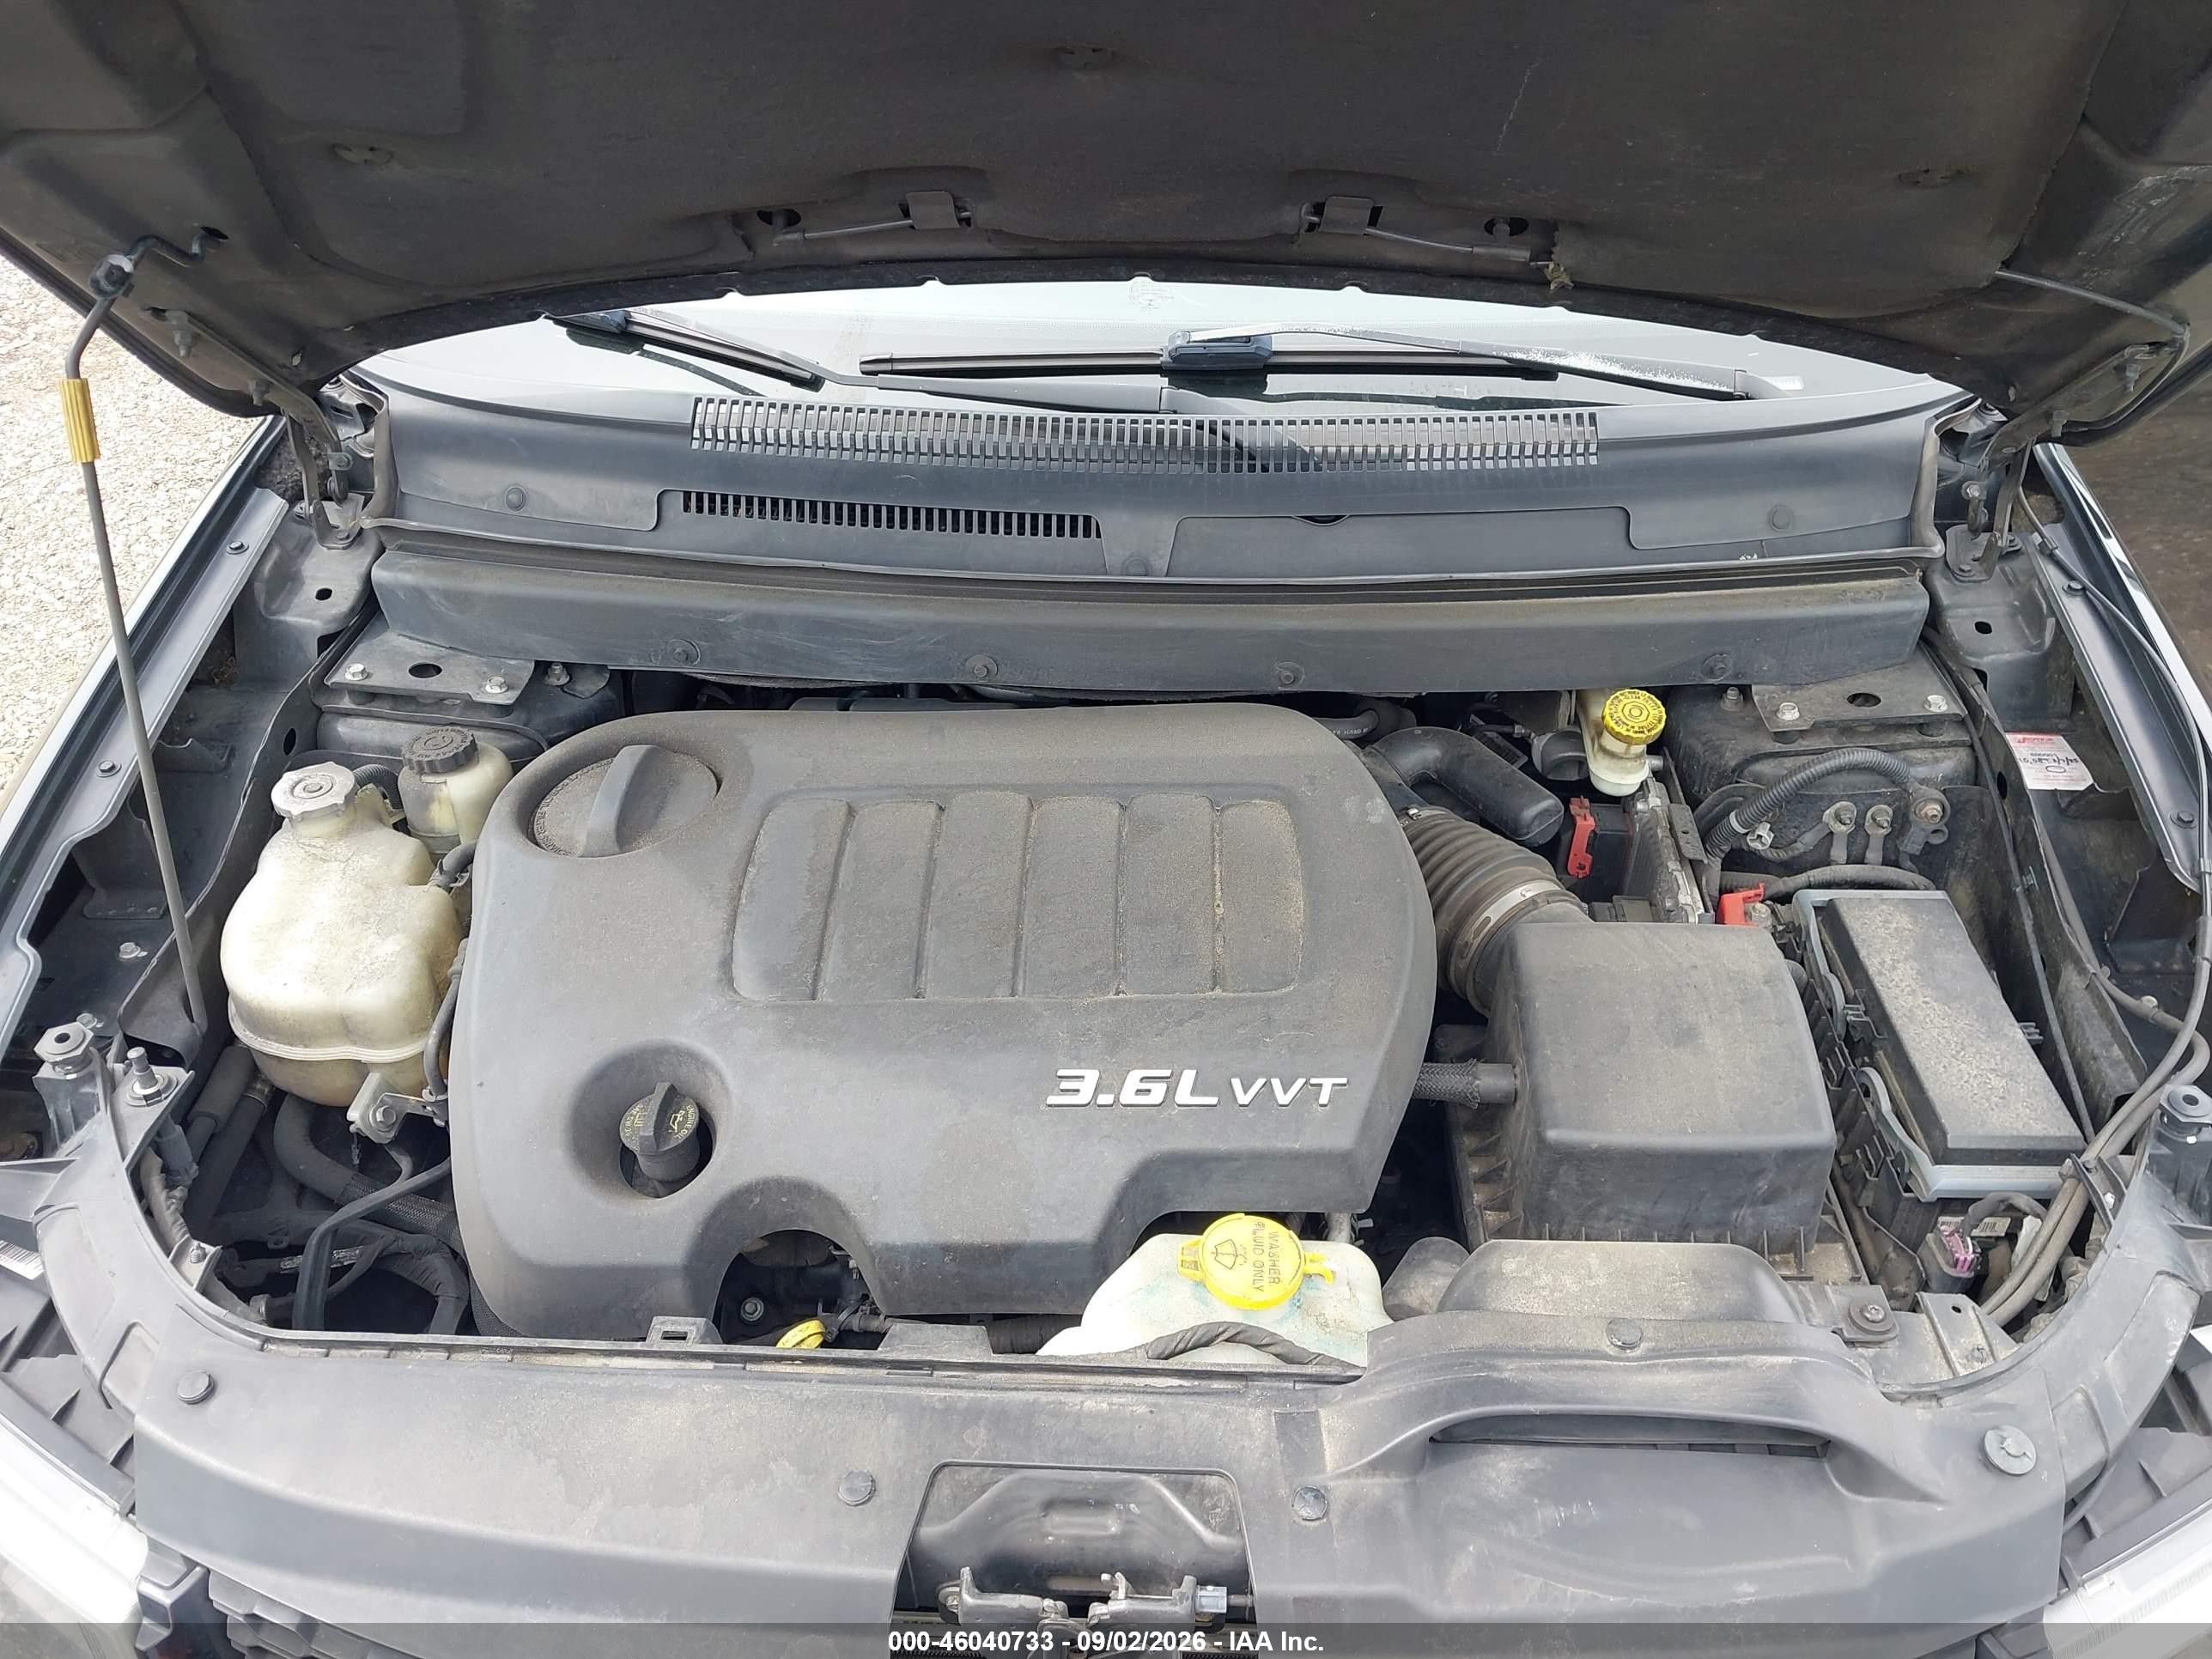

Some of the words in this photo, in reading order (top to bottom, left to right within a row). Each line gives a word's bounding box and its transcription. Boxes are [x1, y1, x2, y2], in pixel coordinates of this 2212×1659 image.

[538, 797, 554, 811] OIL
[535, 811, 547, 836] FILTER
[1046, 1068, 1220, 1108] 3.6L
[1230, 1078, 1348, 1108] VVT
[685, 1104, 696, 1129] ENGINE
[673, 1129, 688, 1140] OIL
[1251, 1221, 1266, 1255] FLUID
[1267, 1231, 1281, 1285] WASHER
[1251, 1260, 1265, 1292] ONLY
